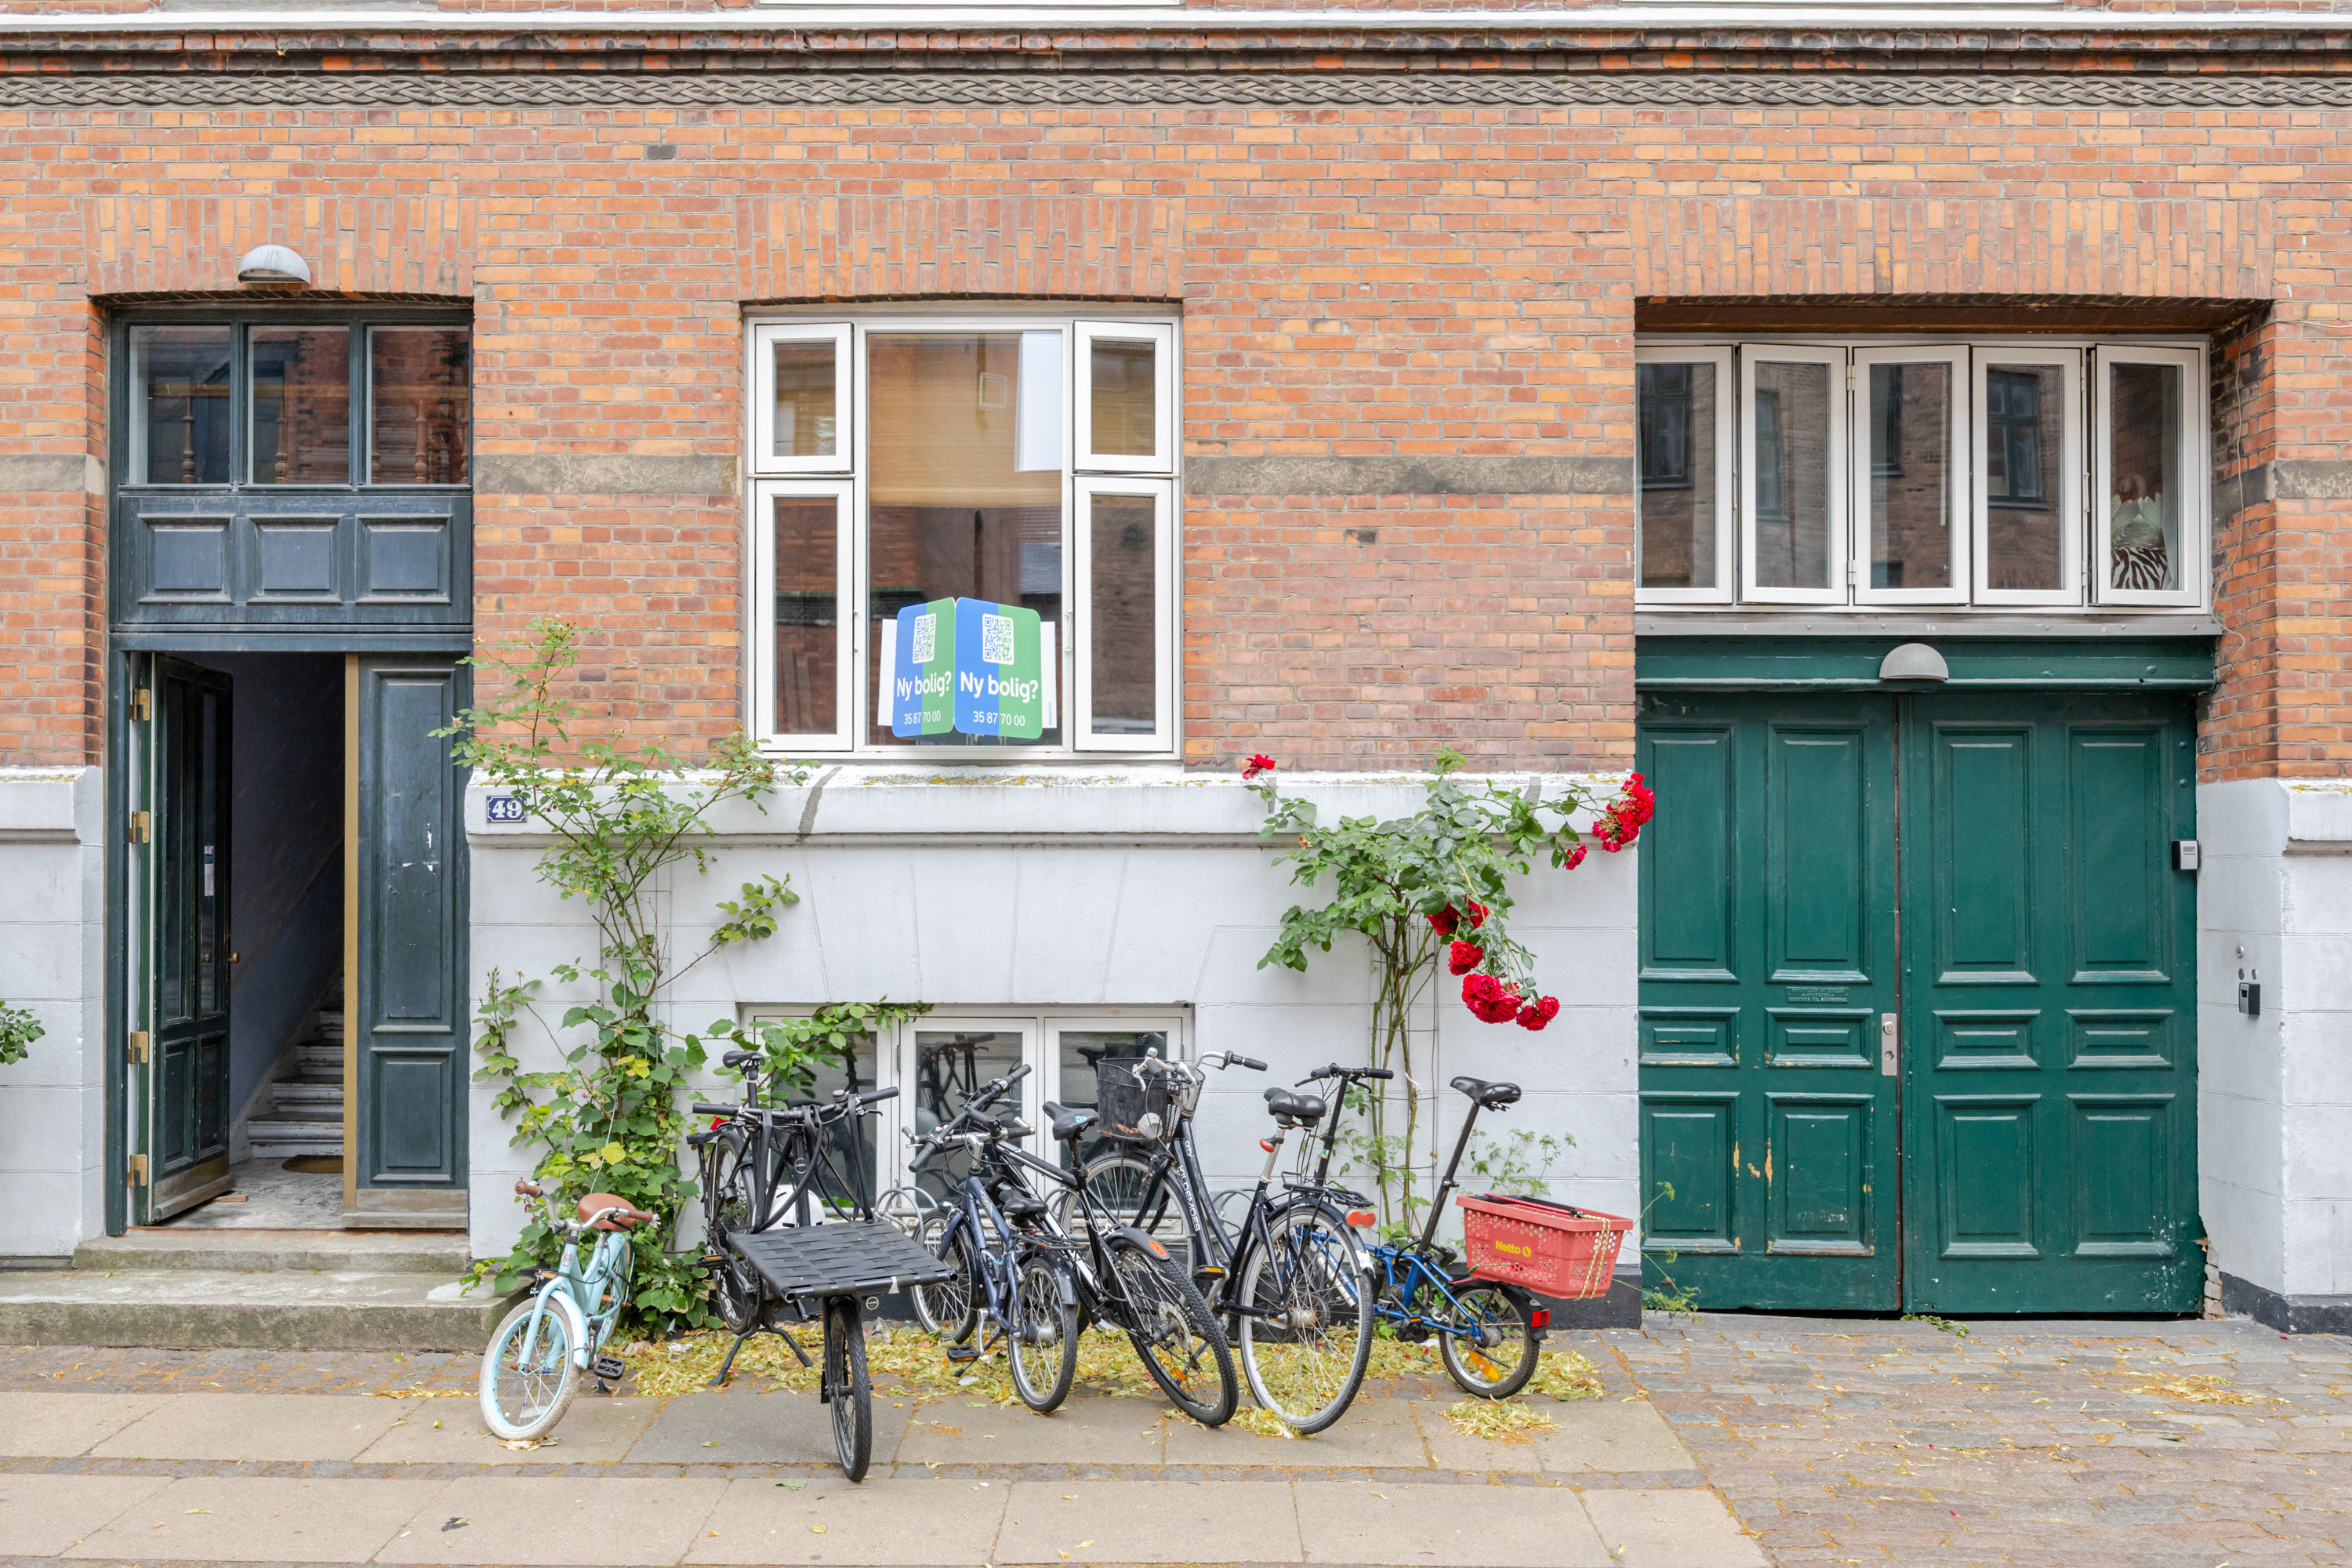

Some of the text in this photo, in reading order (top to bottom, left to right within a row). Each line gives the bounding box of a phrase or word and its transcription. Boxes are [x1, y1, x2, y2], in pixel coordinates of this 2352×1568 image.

[897, 671, 952, 701] Ny bolig?
[960, 671, 1038, 703] Ny bolig?
[904, 710, 941, 725] 35 87 70 00
[973, 710, 1025, 727] 35 87 70 00
[492, 800, 522, 818] 49
[1178, 1165, 1201, 1232] KILDEMOES
[1495, 1240, 1521, 1254] Netto
